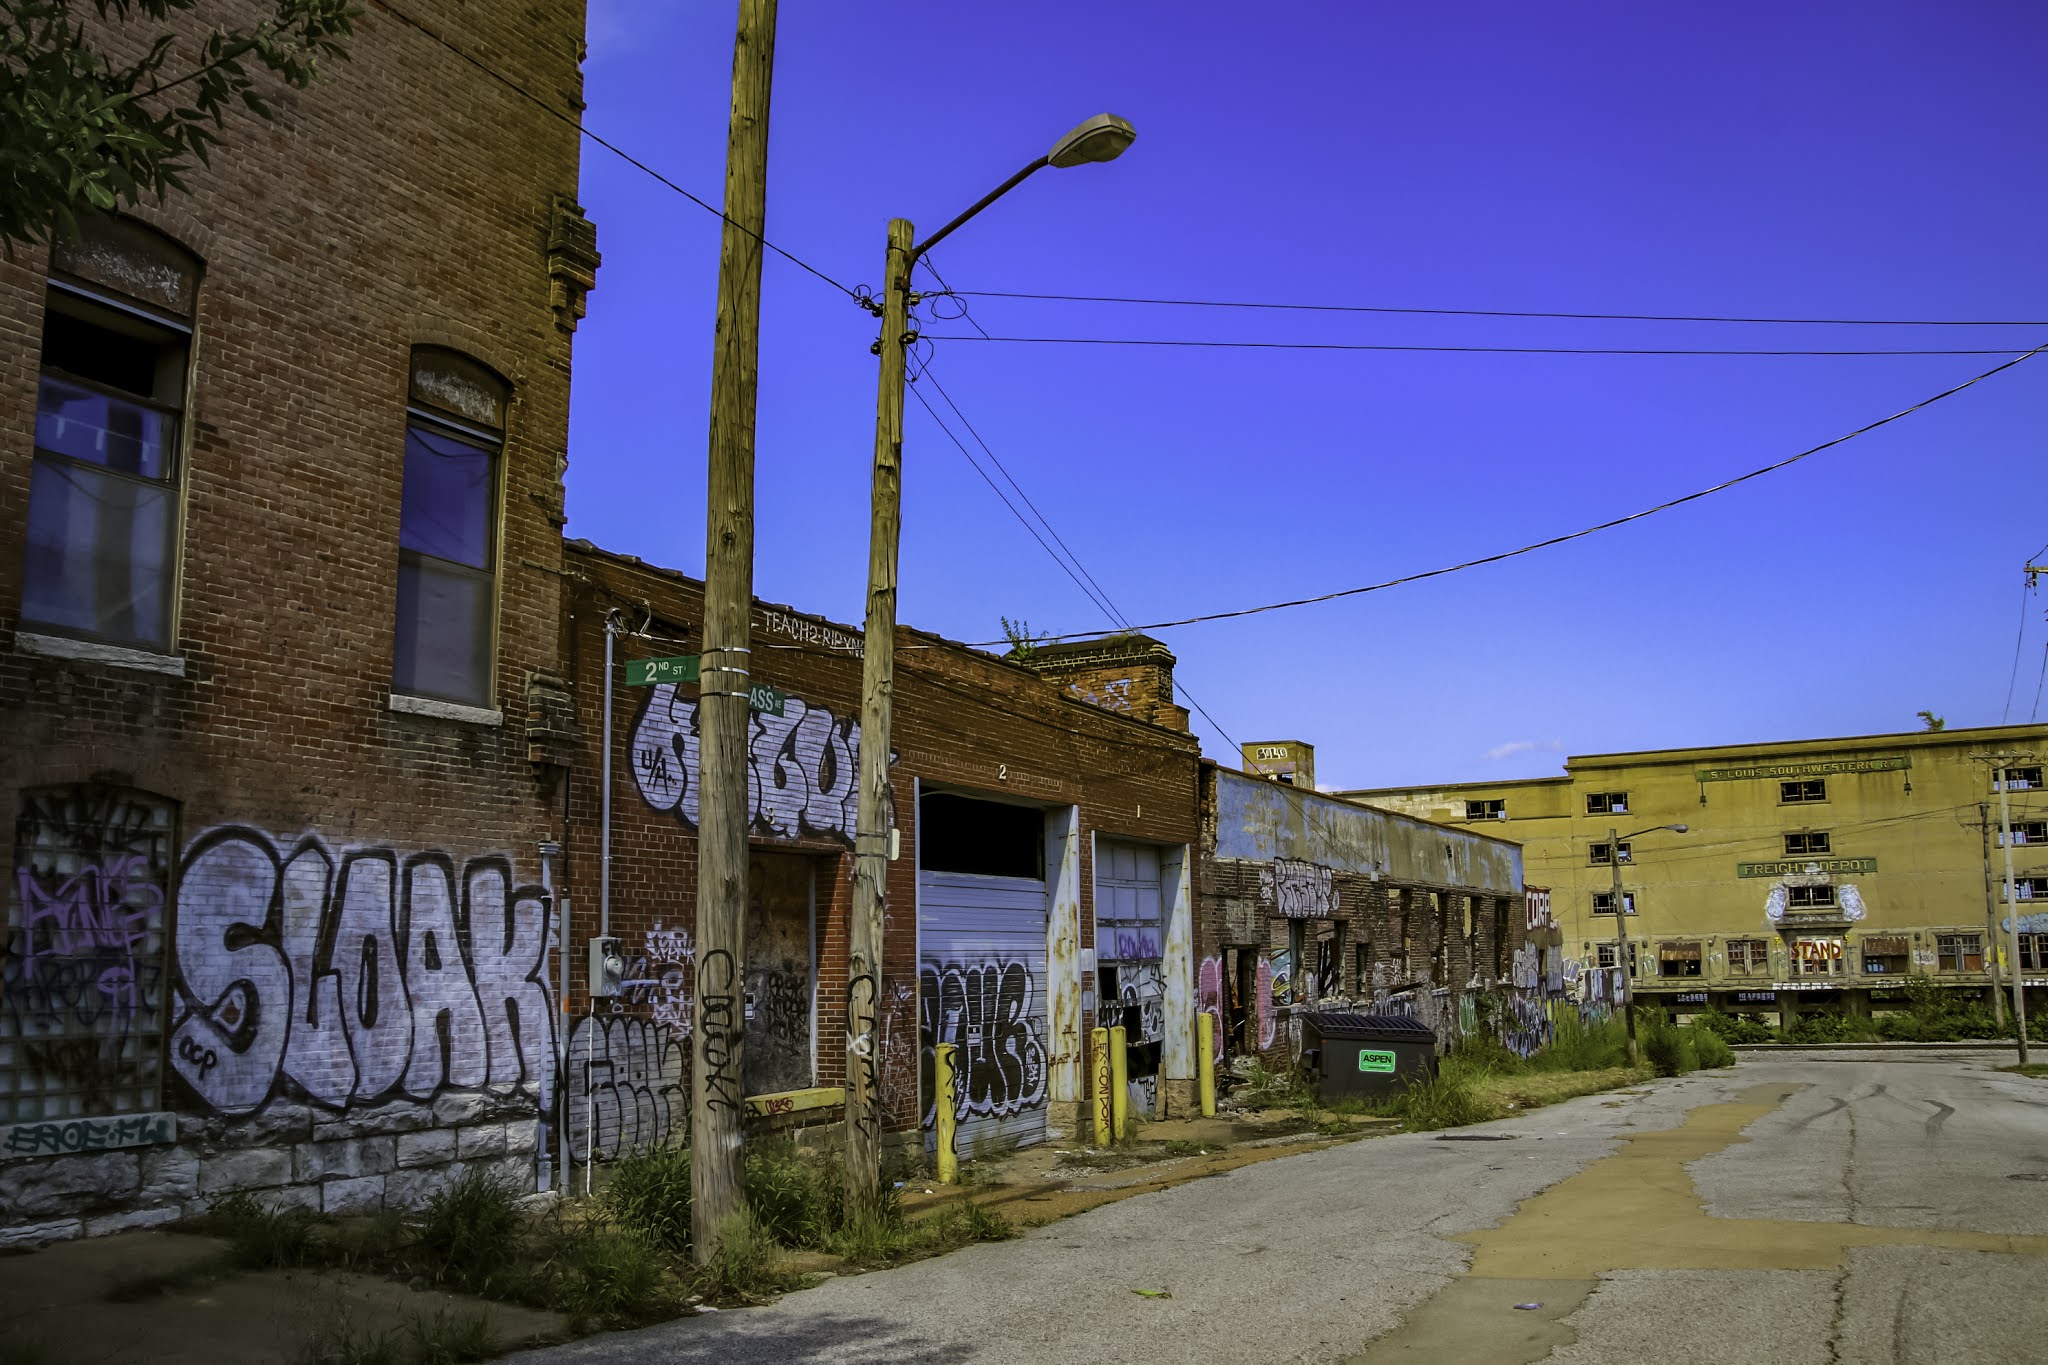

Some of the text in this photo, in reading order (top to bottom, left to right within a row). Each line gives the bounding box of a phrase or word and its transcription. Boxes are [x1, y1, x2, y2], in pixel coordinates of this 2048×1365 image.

[645, 661, 669, 681] 2ND
[749, 687, 774, 711] ASS
[999, 764, 1007, 780] 2
[1727, 768, 1763, 778] LOUIS
[1769, 761, 1874, 775] SOUTHWESTERN
[1744, 860, 1869, 875] FREIGHT DEPOT
[1791, 941, 1841, 960] STAND
[1363, 1054, 1392, 1064] ASPEN
[1098, 1042, 1111, 1132] EX-CONDOM
